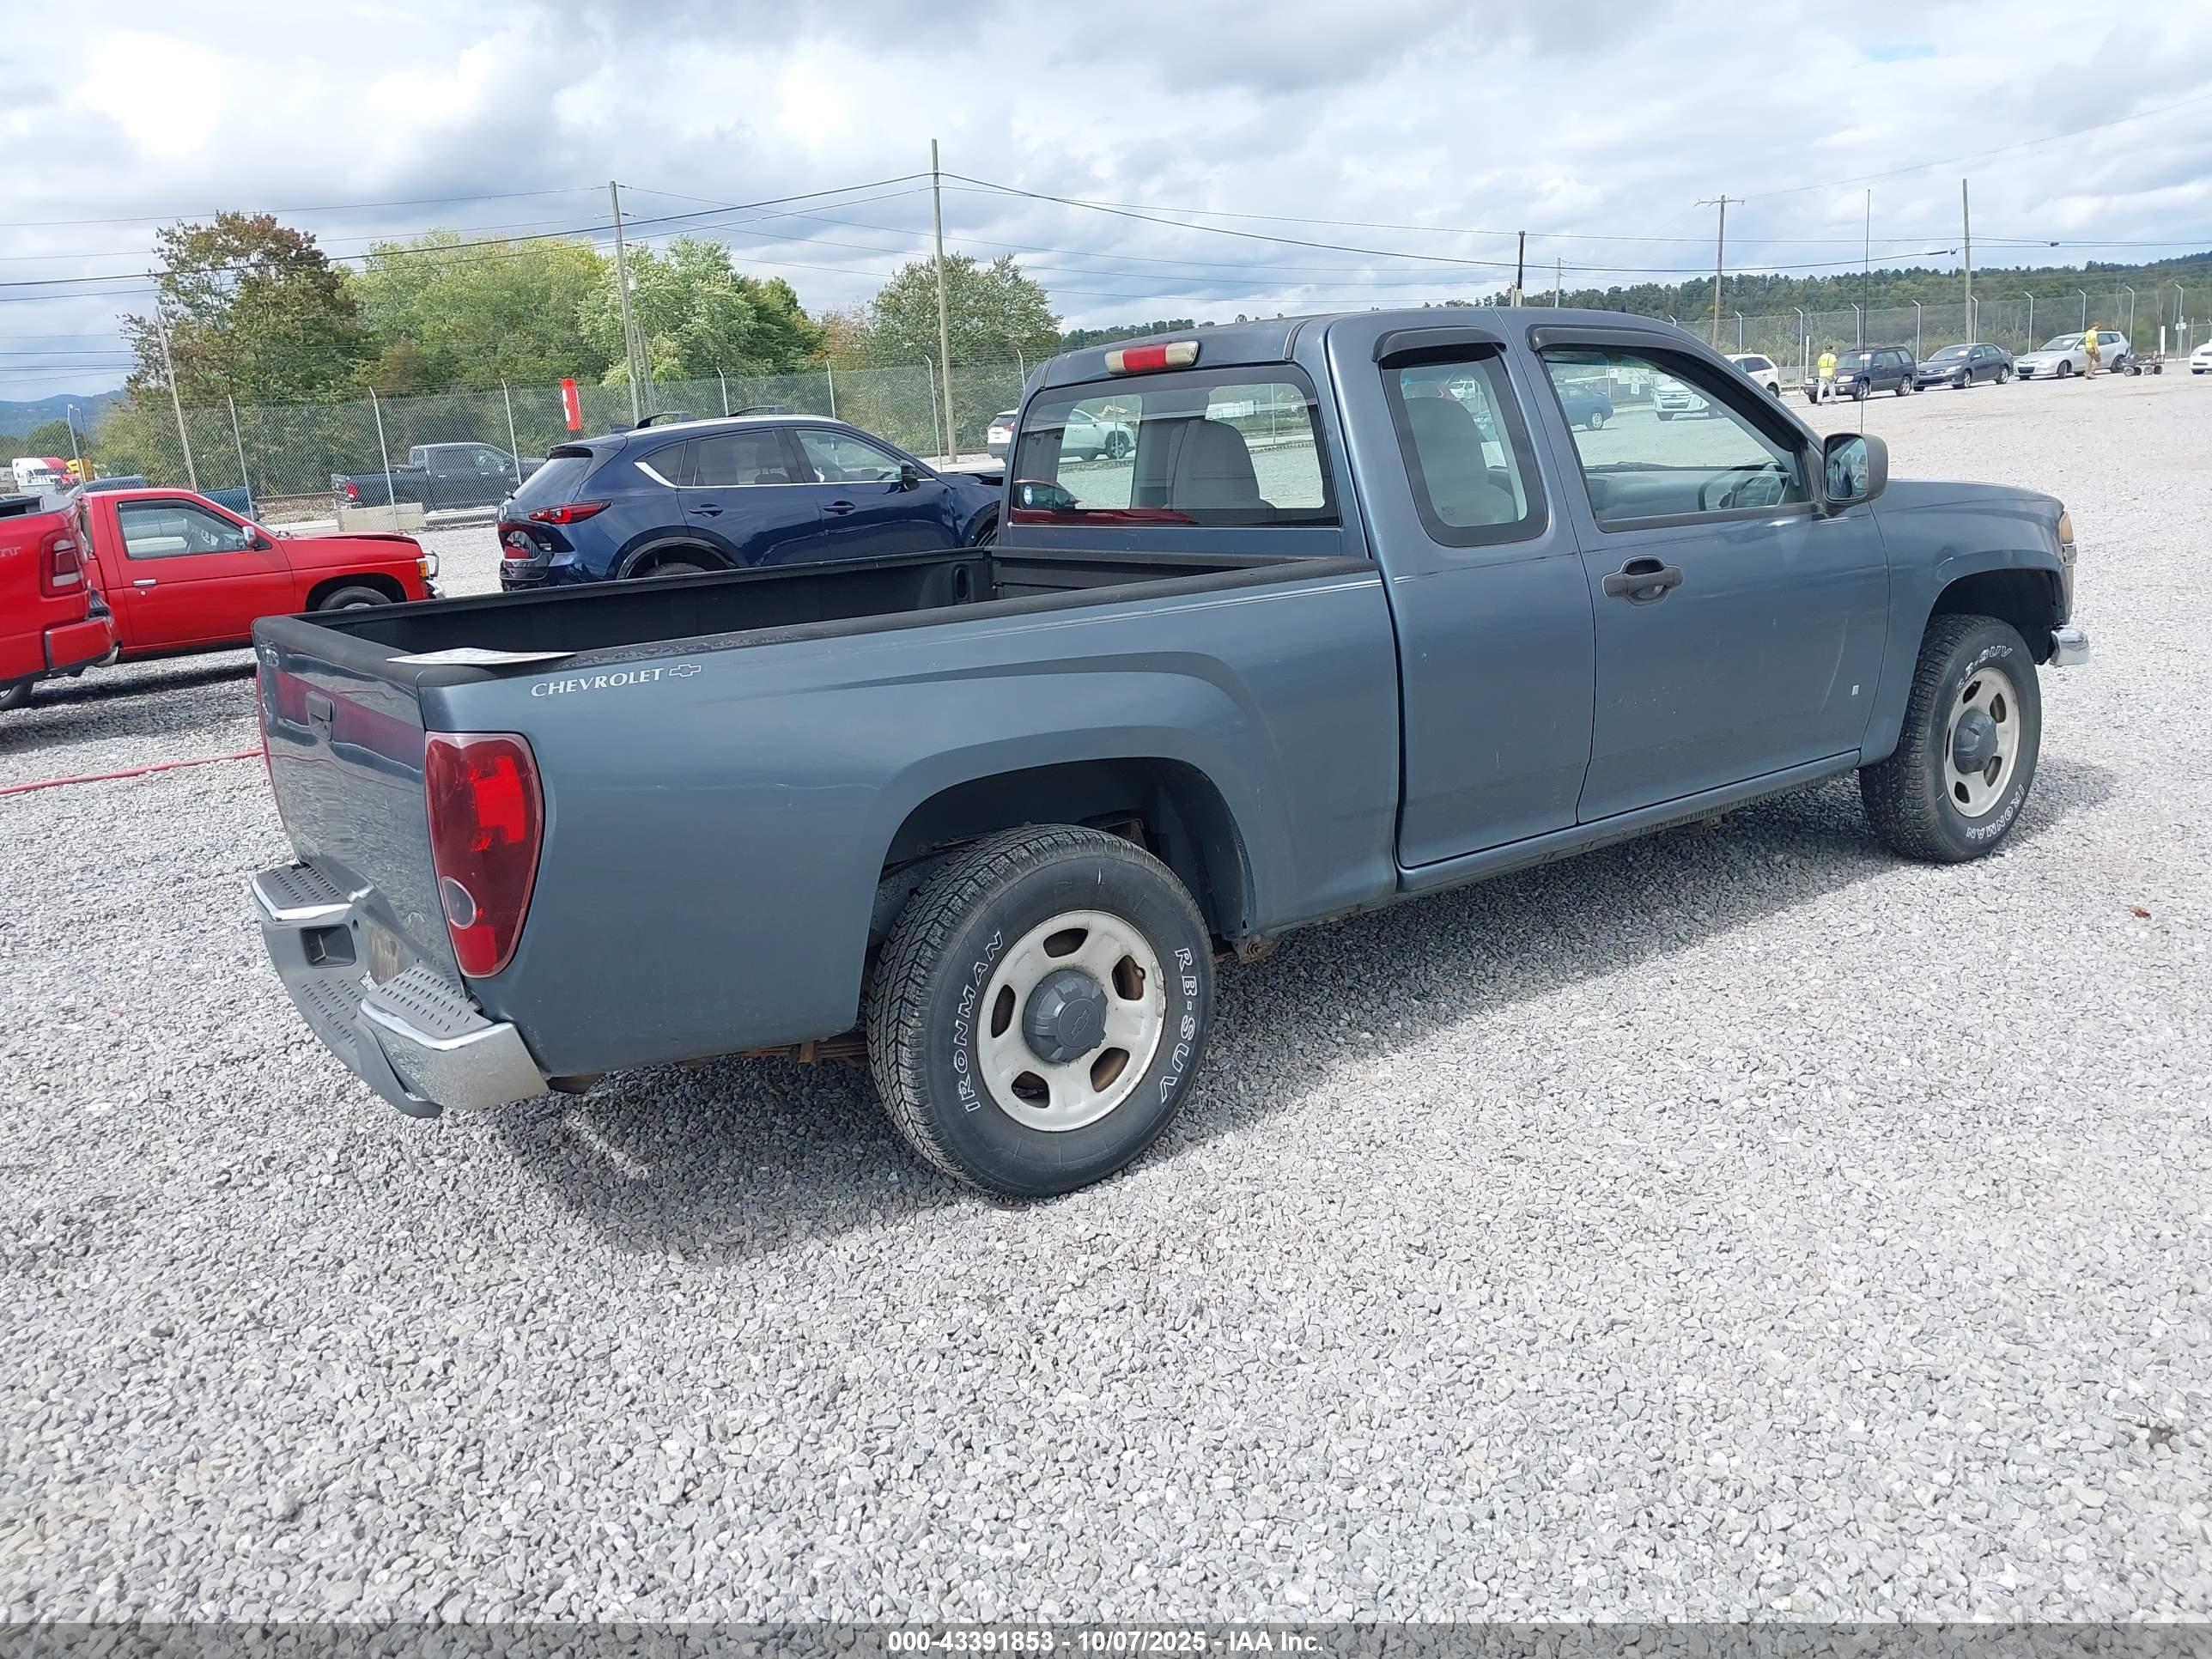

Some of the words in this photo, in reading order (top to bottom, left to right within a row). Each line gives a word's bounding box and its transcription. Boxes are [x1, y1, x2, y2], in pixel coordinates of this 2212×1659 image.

[531, 667, 665, 697] CHEVROLET
[1966, 783, 2026, 840] IRONMAN
[951, 929, 1006, 1114] IRONMAN
[1160, 946, 1199, 1105] RB-SUV
